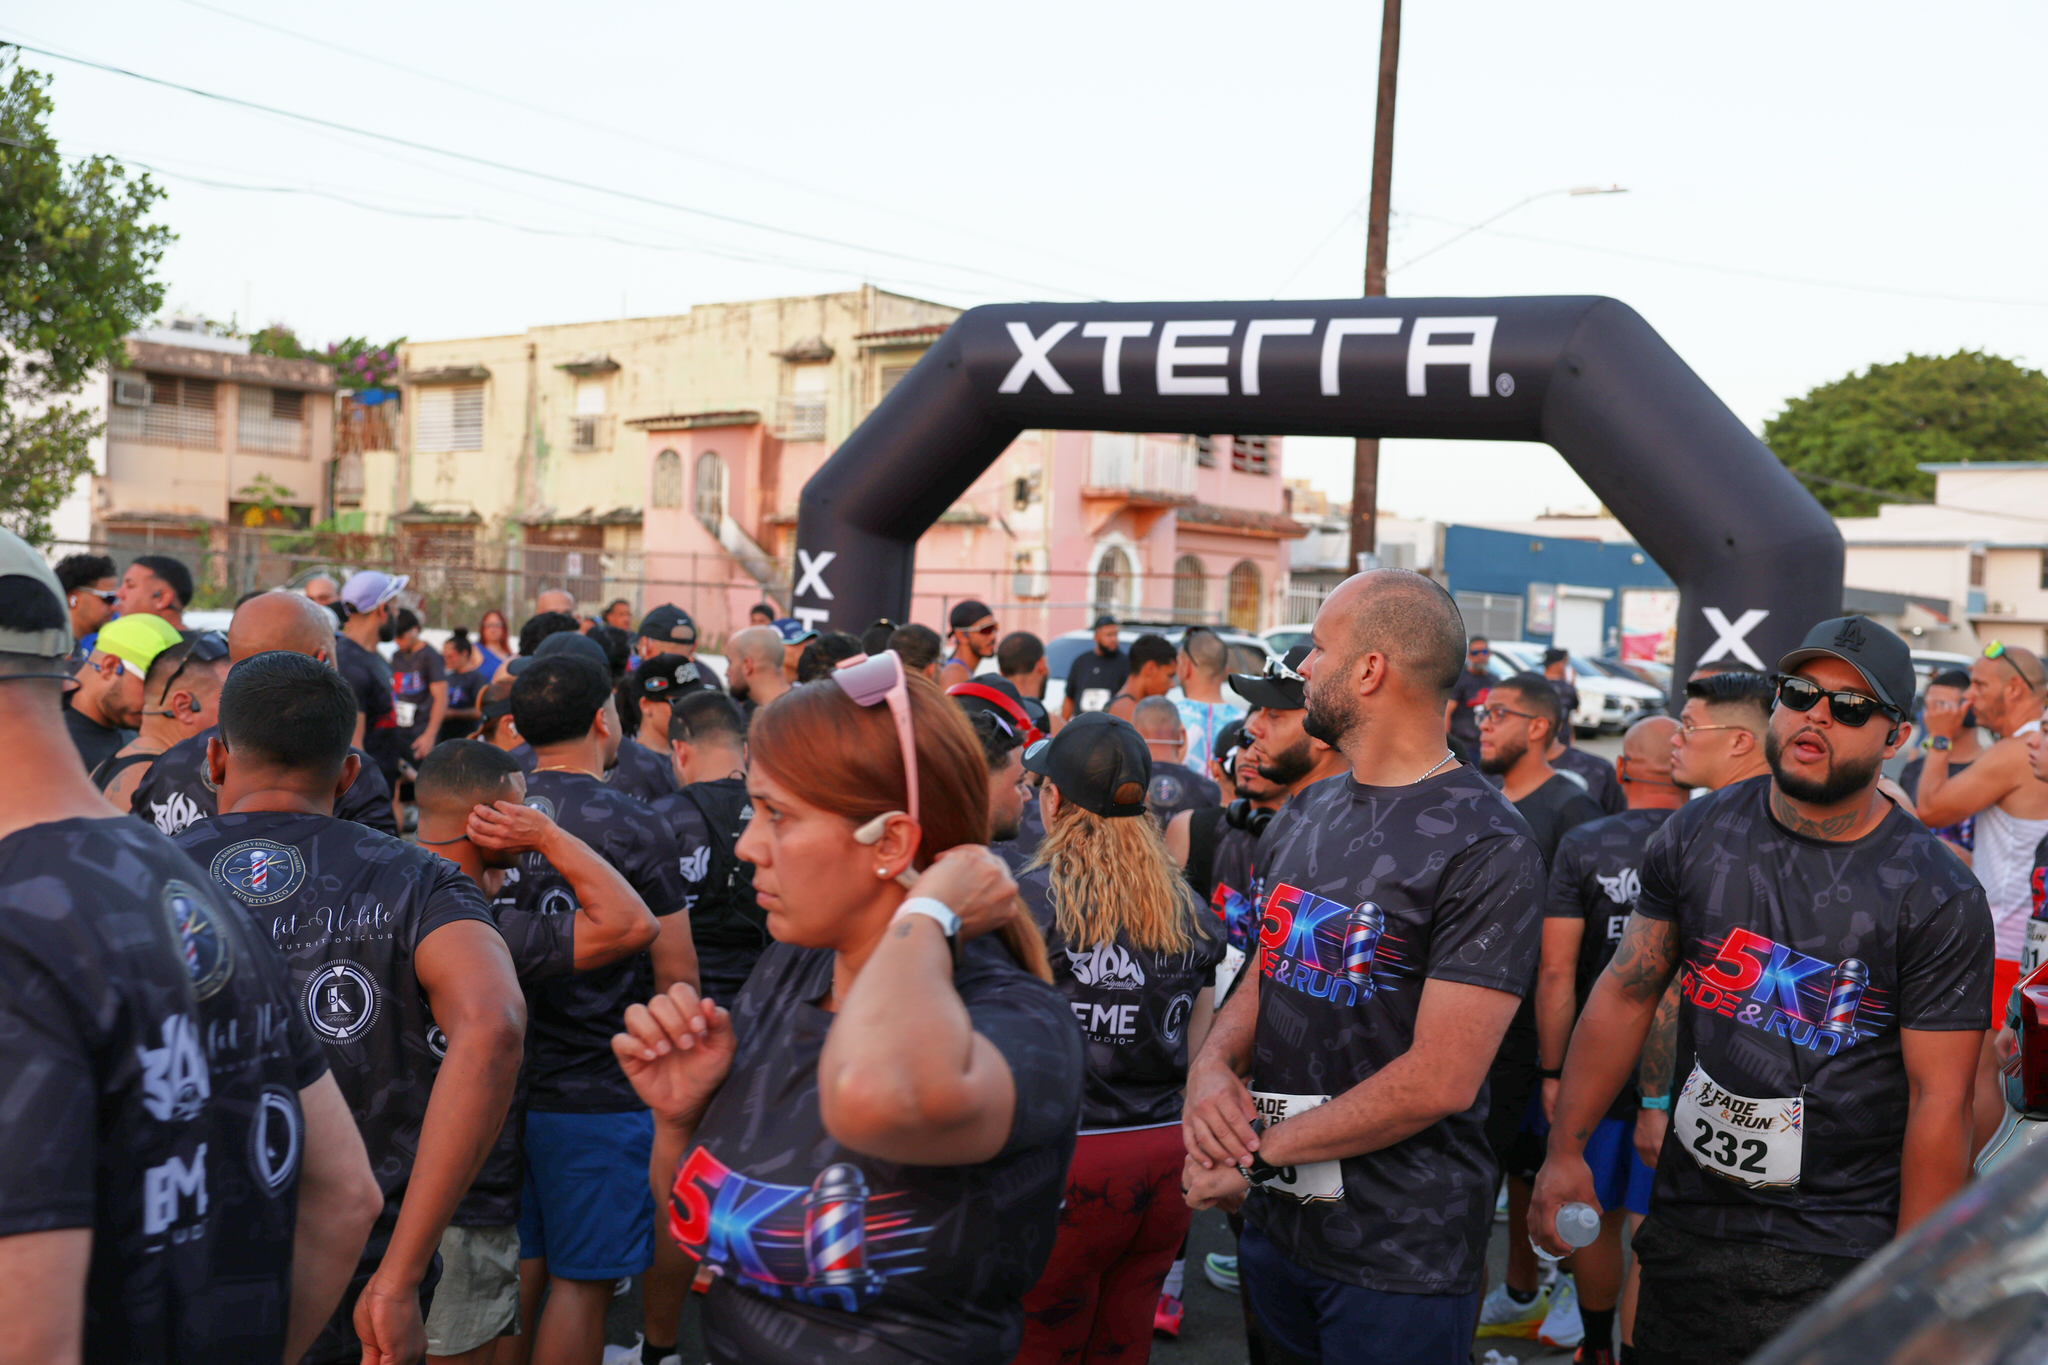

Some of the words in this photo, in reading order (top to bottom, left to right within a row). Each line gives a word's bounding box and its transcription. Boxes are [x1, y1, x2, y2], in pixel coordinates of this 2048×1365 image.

[232, 890, 267, 904] PUERTO
[268, 889, 289, 902] RICO
[361, 933, 394, 941] CLUB
[1259, 883, 1352, 969] 5K
[1275, 960, 1291, 985] &
[1290, 964, 1358, 1007] RUN
[1702, 927, 1835, 1017] 5K
[1070, 1002, 1140, 1034] EME
[1681, 971, 1743, 1018] FADE
[1737, 1003, 1764, 1028] &
[1763, 1009, 1841, 1056] RUN
[1712, 1089, 1759, 1116] FADE
[1720, 1109, 1731, 1120] &
[1731, 1114, 1774, 1130] RUN
[1693, 1117, 1768, 1174] 232
[669, 1146, 811, 1283] 5K
